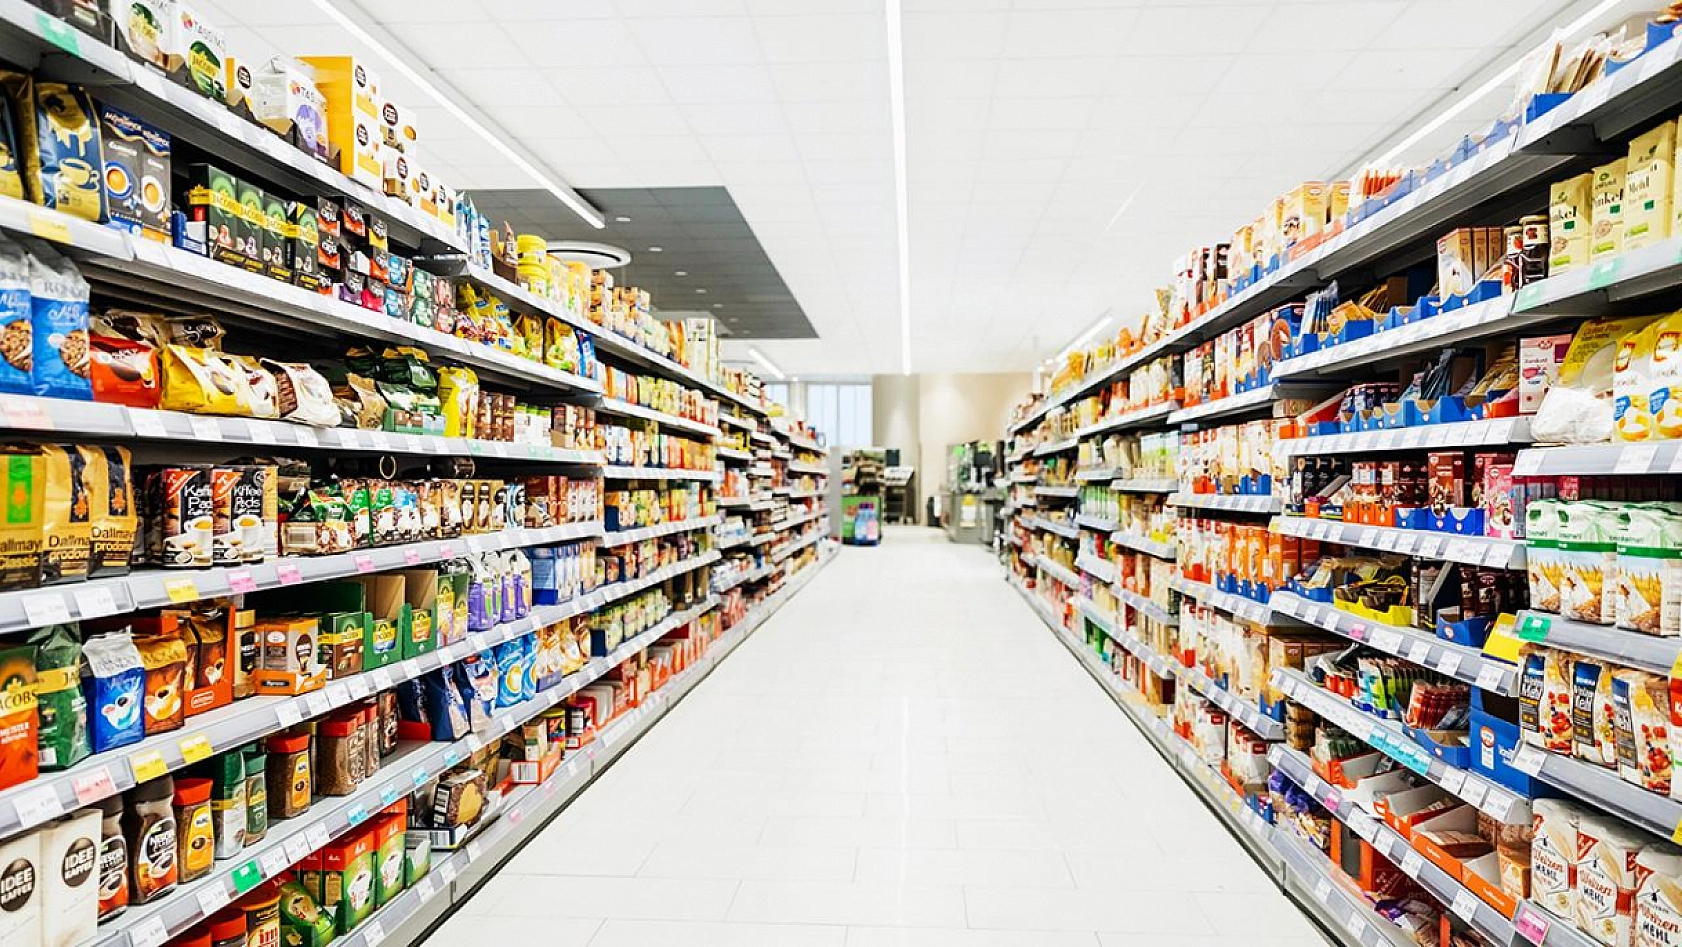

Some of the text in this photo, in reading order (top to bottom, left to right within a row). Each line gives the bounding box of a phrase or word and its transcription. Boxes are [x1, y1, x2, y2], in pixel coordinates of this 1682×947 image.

[64, 846, 95, 871] IDEE
[0, 867, 33, 894] IDEE
[1638, 902, 1680, 933] Weizen
[1642, 919, 1671, 945] MEHL
